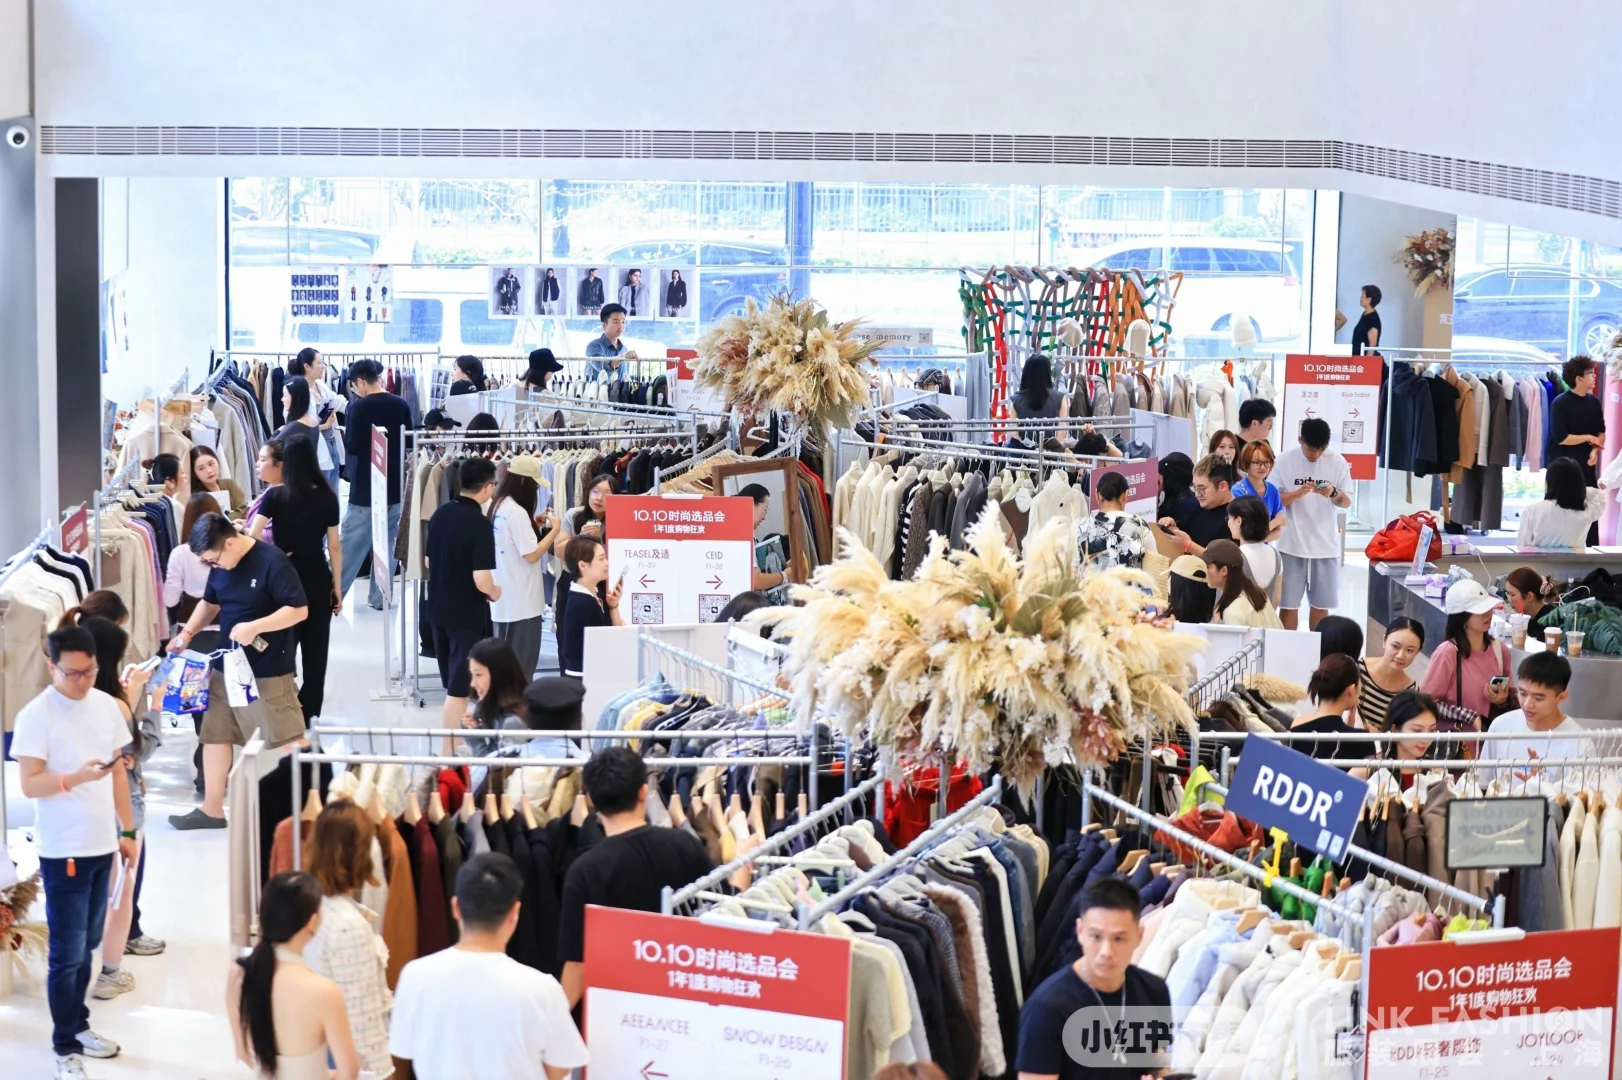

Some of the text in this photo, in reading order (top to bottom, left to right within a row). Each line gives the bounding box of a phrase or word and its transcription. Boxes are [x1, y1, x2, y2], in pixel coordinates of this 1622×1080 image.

[876, 333, 912, 341] memory
[1303, 364, 1364, 373] 10.10时尚选品会
[633, 510, 726, 523] 10.10时尚选品会
[653, 524, 706, 534] 1年1度购物狂欢
[624, 548, 670, 560] TEASEL及适
[705, 551, 723, 560] CEID
[632, 939, 799, 980] 10.10时尚选品会
[1415, 956, 1573, 992] 10.10时尚选品会
[667, 970, 762, 998] 1年1度购物狂欢
[1448, 986, 1538, 1011] 1年1度购物狂欢
[723, 1026, 776, 1046] SNOW
[1515, 1028, 1584, 1050] JOYLOOP
[1418, 1065, 1450, 1079] F1-25
